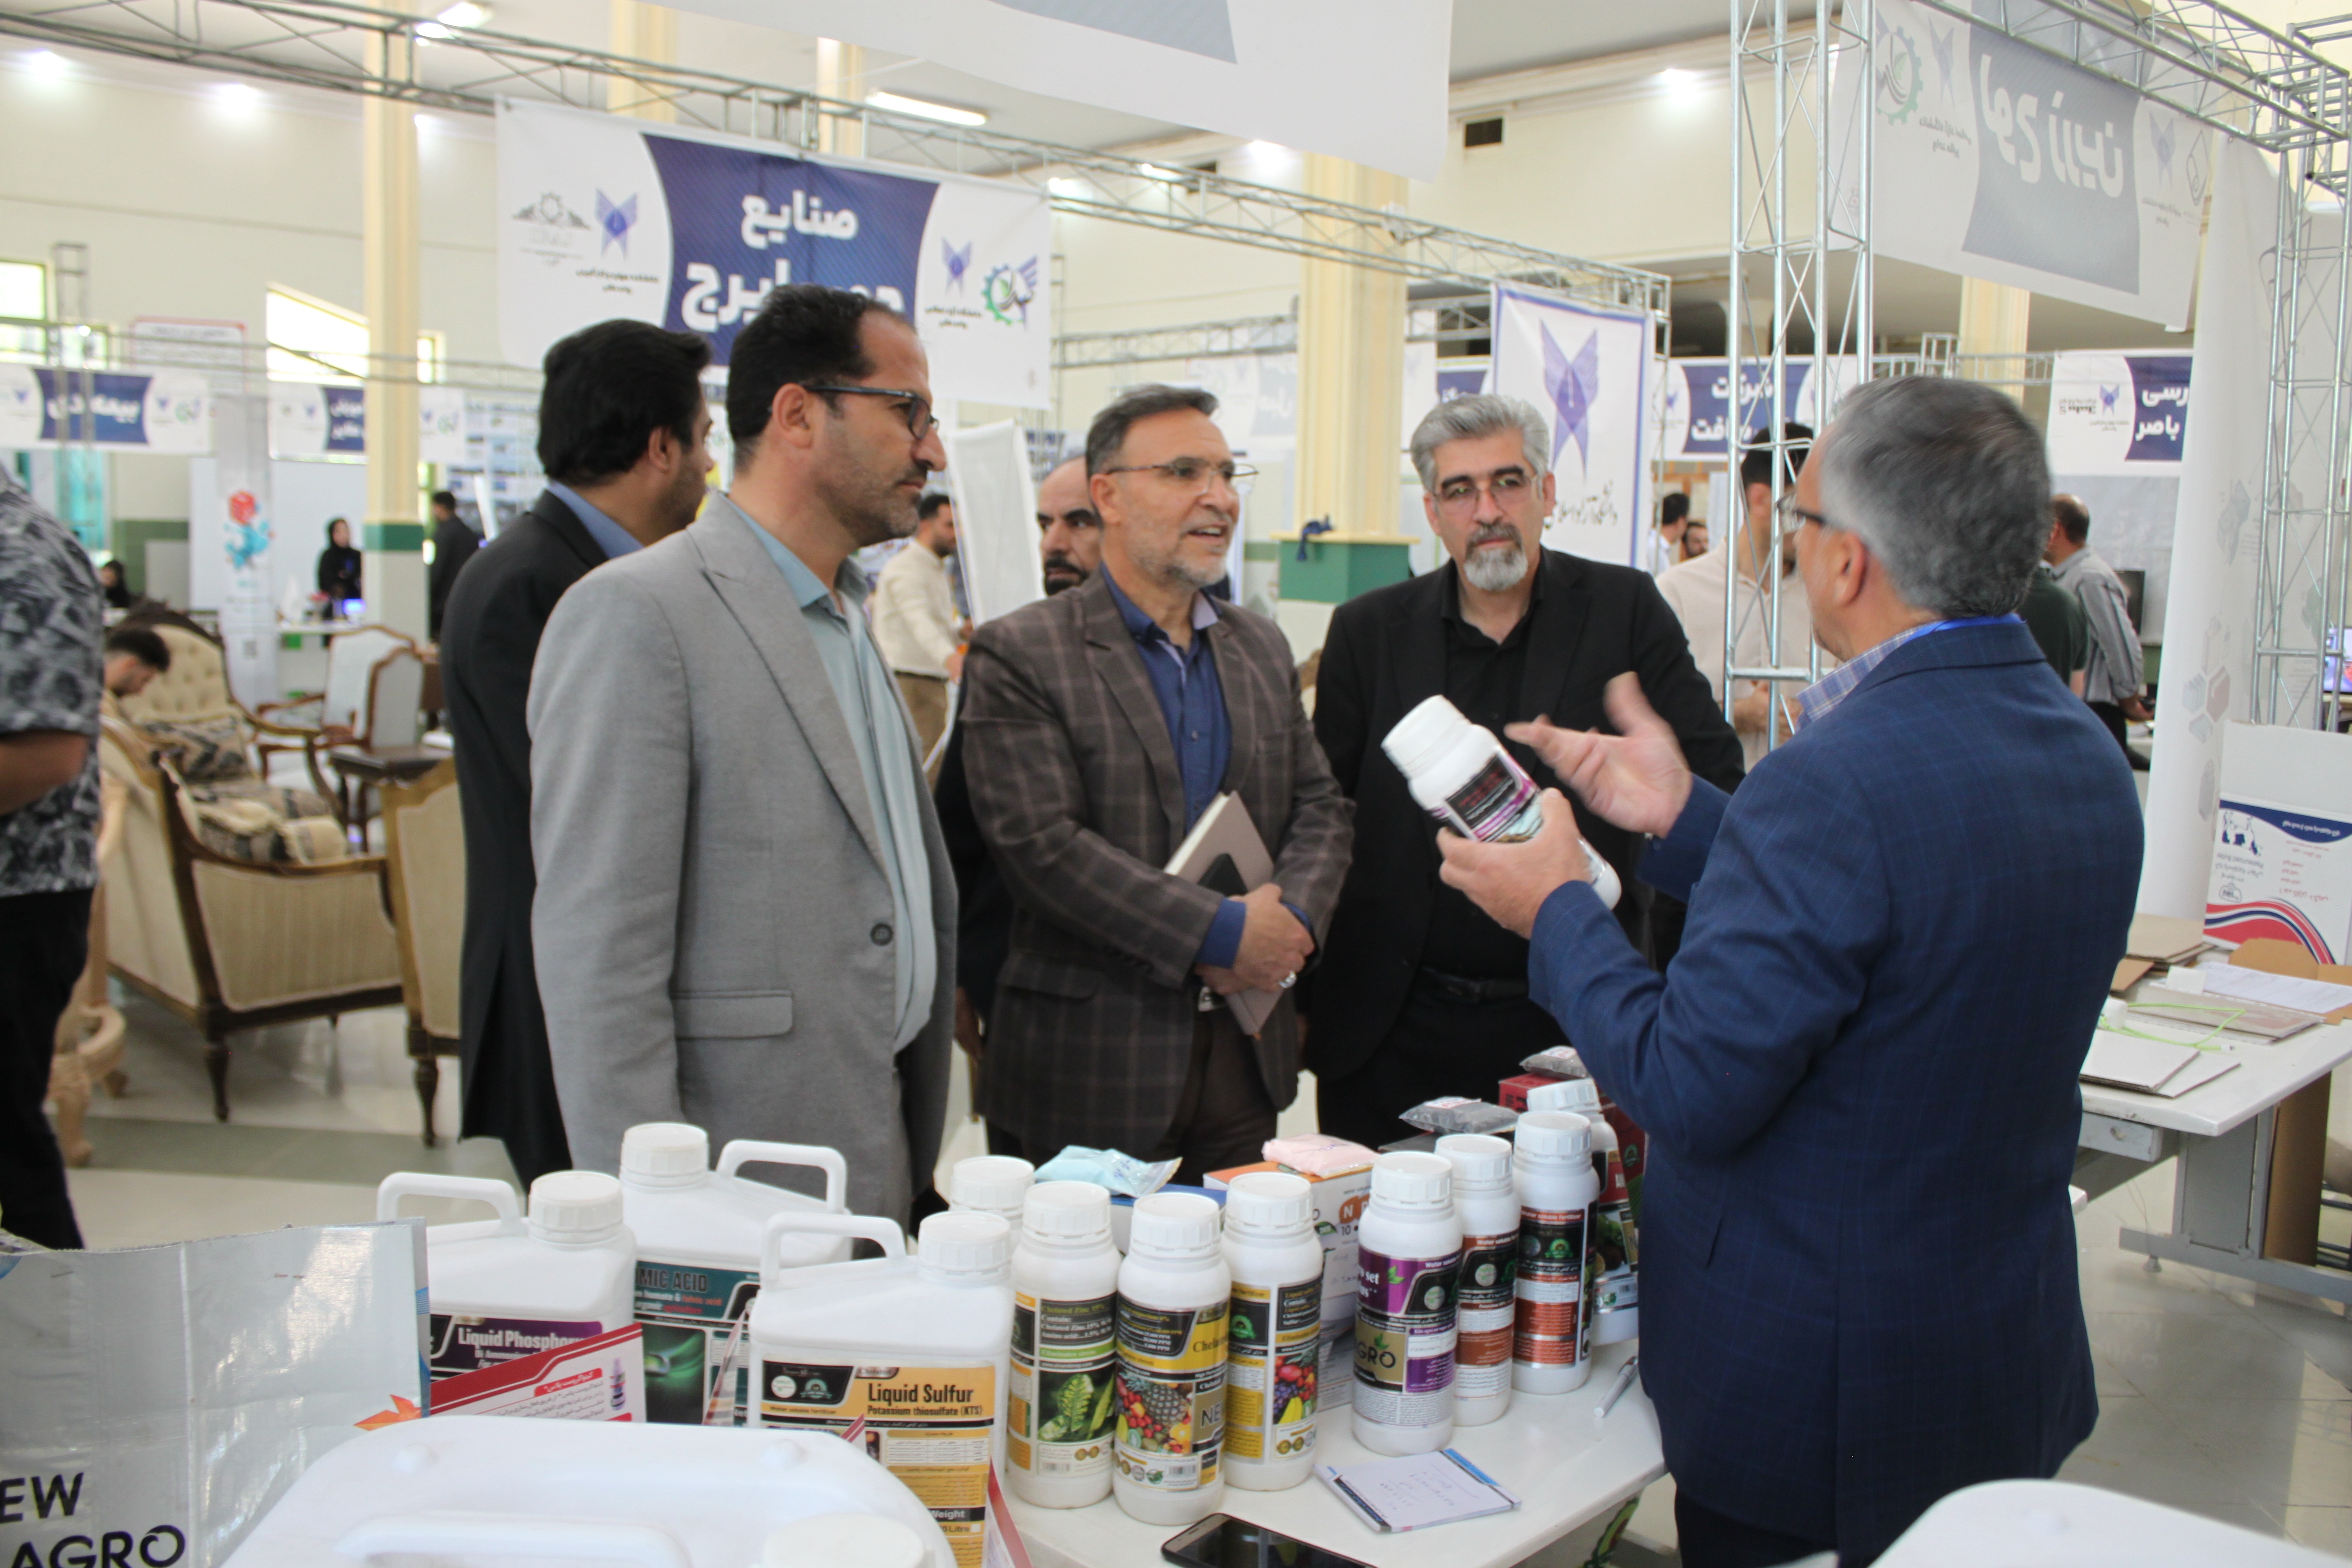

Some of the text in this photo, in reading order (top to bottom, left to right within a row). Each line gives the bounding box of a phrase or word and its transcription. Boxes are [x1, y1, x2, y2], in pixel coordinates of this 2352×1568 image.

[741, 190, 859, 249] صنایع
[1343, 1205, 1354, 1219] N
[1341, 1225, 1351, 1235] 10
[672, 1272, 708, 1293] ACID
[458, 1327, 502, 1349] Liquid
[868, 1383, 974, 1406] Liquid Sulfur
[868, 1405, 983, 1416] Potassium thiosulfate (KTS)
[11, 1524, 186, 1568] AGRO
